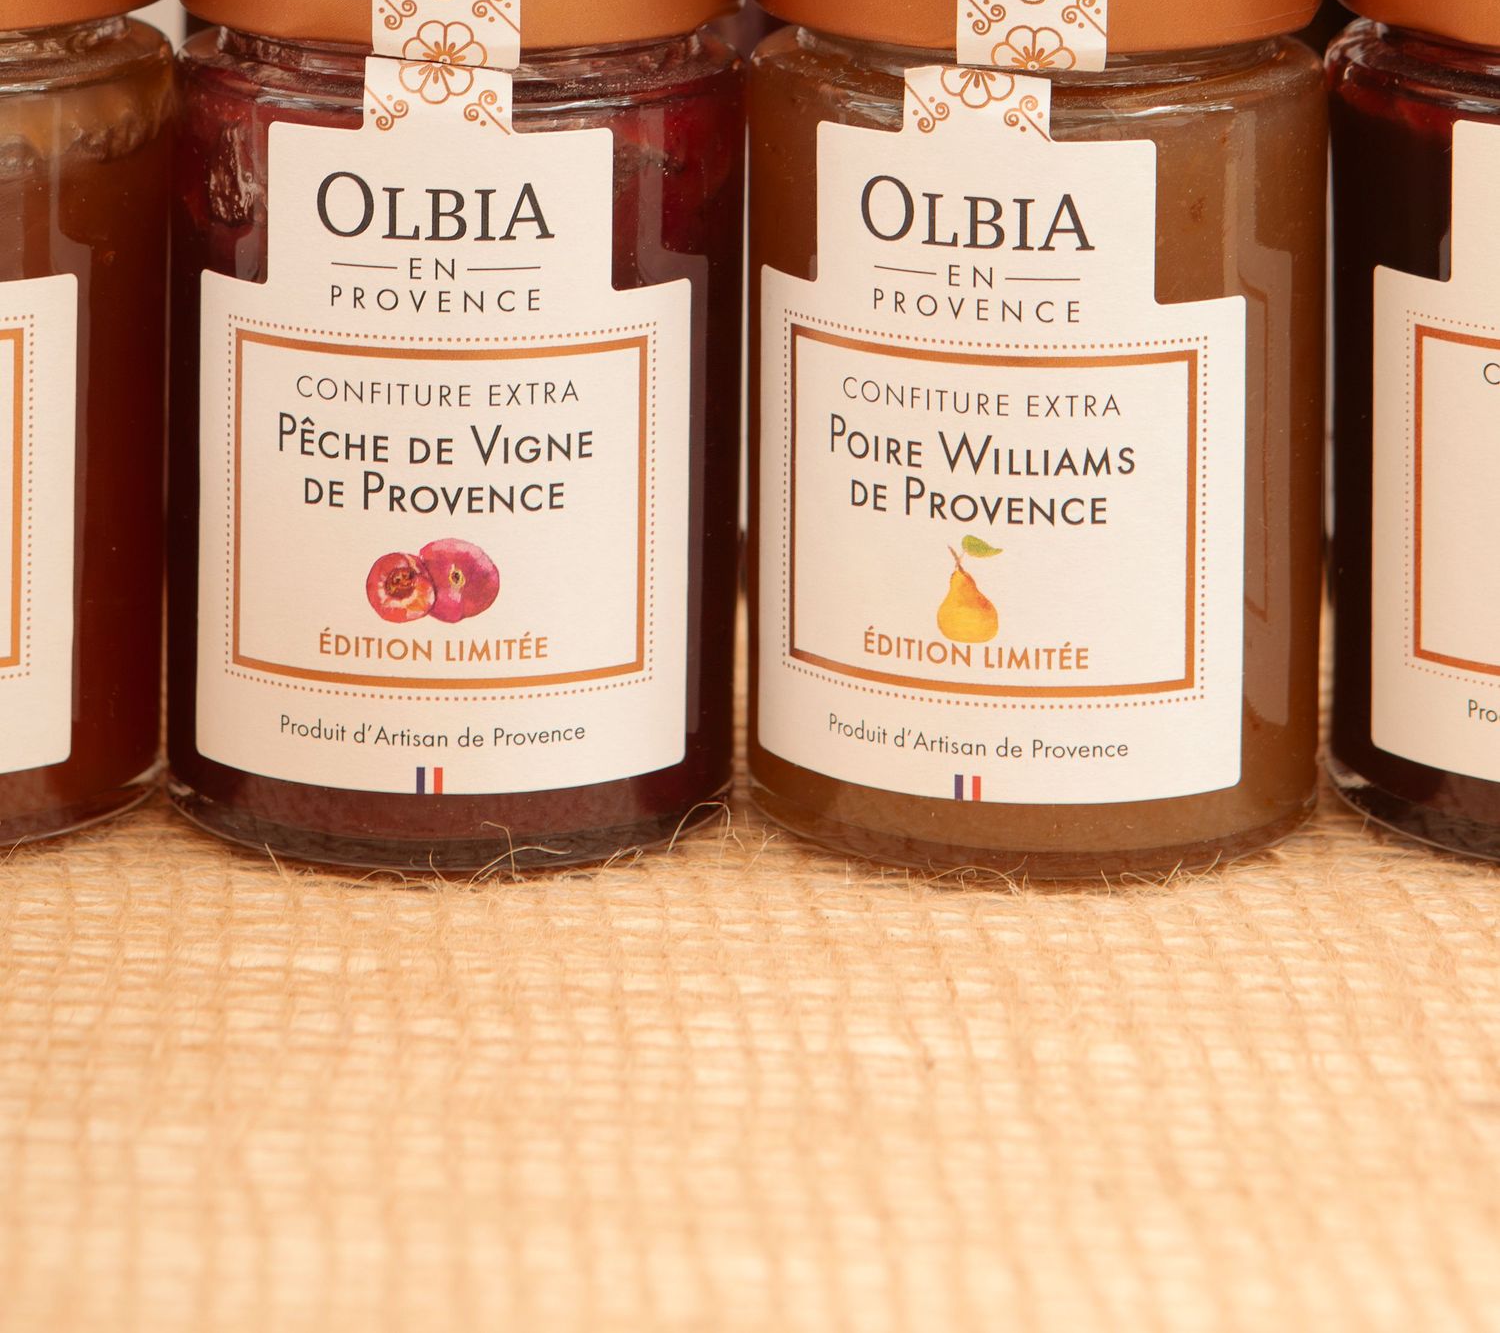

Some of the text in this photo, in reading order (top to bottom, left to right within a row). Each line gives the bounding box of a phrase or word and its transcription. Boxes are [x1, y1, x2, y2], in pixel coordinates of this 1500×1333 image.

[317, 171, 555, 241] OLBIA
[861, 175, 1095, 251] OLBIA
[410, 258, 455, 280] EN
[949, 264, 992, 289] EN
[331, 285, 540, 313] PROVENCE
[874, 285, 1079, 323] PROVENCE
[297, 376, 578, 407] CONFITURE EXTRA
[842, 377, 1120, 417] CONFITURE EXTRA
[279, 412, 592, 466] PÊCHE DE VIGNE
[831, 413, 1135, 477] POIRE WILLIAMS
[305, 471, 564, 515] DE PROVENCE
[852, 475, 1108, 526] DE PROVENCE
[320, 627, 548, 662] ÉDITION LIMITÉE
[864, 625, 1088, 670] ÉDITION LIMITÉE
[281, 715, 585, 747] Produit d'Artisan de Provence
[830, 713, 1128, 758] Produit d'Artisan de Provence
